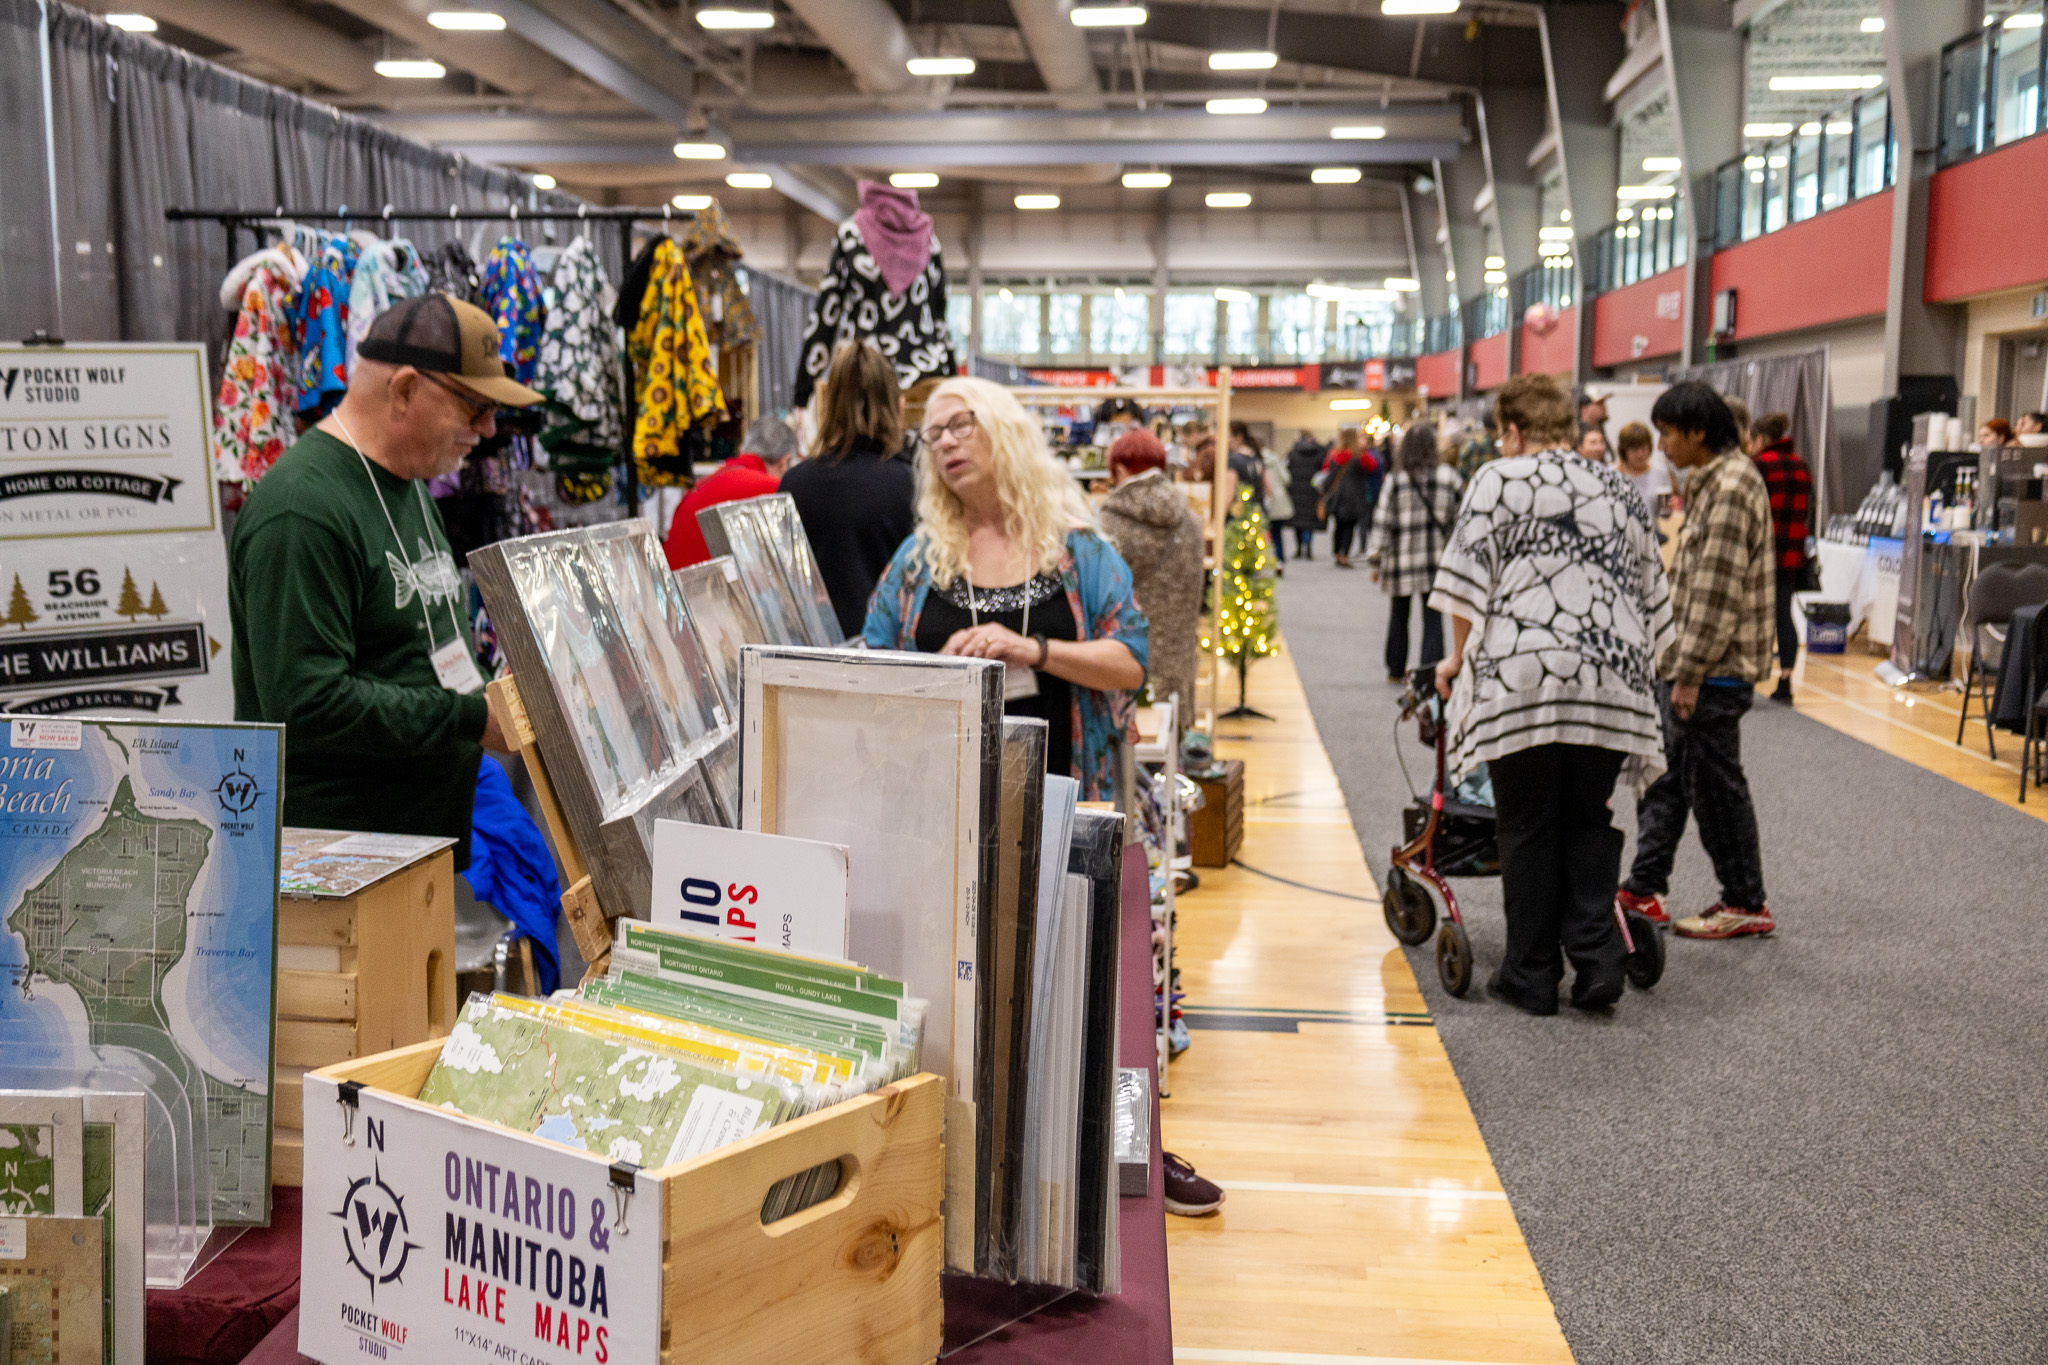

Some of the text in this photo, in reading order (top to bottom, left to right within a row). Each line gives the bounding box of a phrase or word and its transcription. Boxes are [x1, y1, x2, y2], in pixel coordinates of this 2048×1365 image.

[24, 367, 126, 384] POCKET WOLF
[26, 387, 80, 402] STUDIO
[84, 423, 171, 449] SIGNS
[5, 475, 152, 496] HOME OR COTTAGE
[20, 509, 71, 523] METAL
[79, 507, 101, 520] OR
[107, 506, 137, 520] PVC
[48, 568, 101, 598] 56
[56, 611, 101, 622] AVENUE
[41, 639, 190, 673] WILLIAMS
[132, 738, 179, 750] Elk Island
[233, 748, 245, 761] N
[149, 786, 198, 801] Sandy Bay
[13, 824, 71, 836] CANADA
[220, 822, 255, 832] POCKET WOLF
[81, 868, 139, 876] VICTORIA BEACH
[86, 882, 133, 890] MUNICIPALITY
[32, 901, 61, 911] Victoria
[196, 946, 257, 960] Traverse Bay
[631, 938, 663, 952] NORTHWEST
[664, 958, 724, 978] NORTHWEST ONTARIO
[775, 981, 794, 994] ROYAL
[799, 986, 821, 999] GUNDY
[820, 991, 842, 1004] LAKES
[367, 1115, 385, 1153] N
[5, 1160, 18, 1178] N
[446, 1151, 610, 1255] ONTARIO &
[445, 1210, 609, 1320] MANITOBA
[341, 1302, 408, 1346] POCKET WOLF
[443, 1266, 610, 1365] LAKE MAPS
[359, 1336, 388, 1361] STUDIO
[494, 1343, 518, 1363] ART
